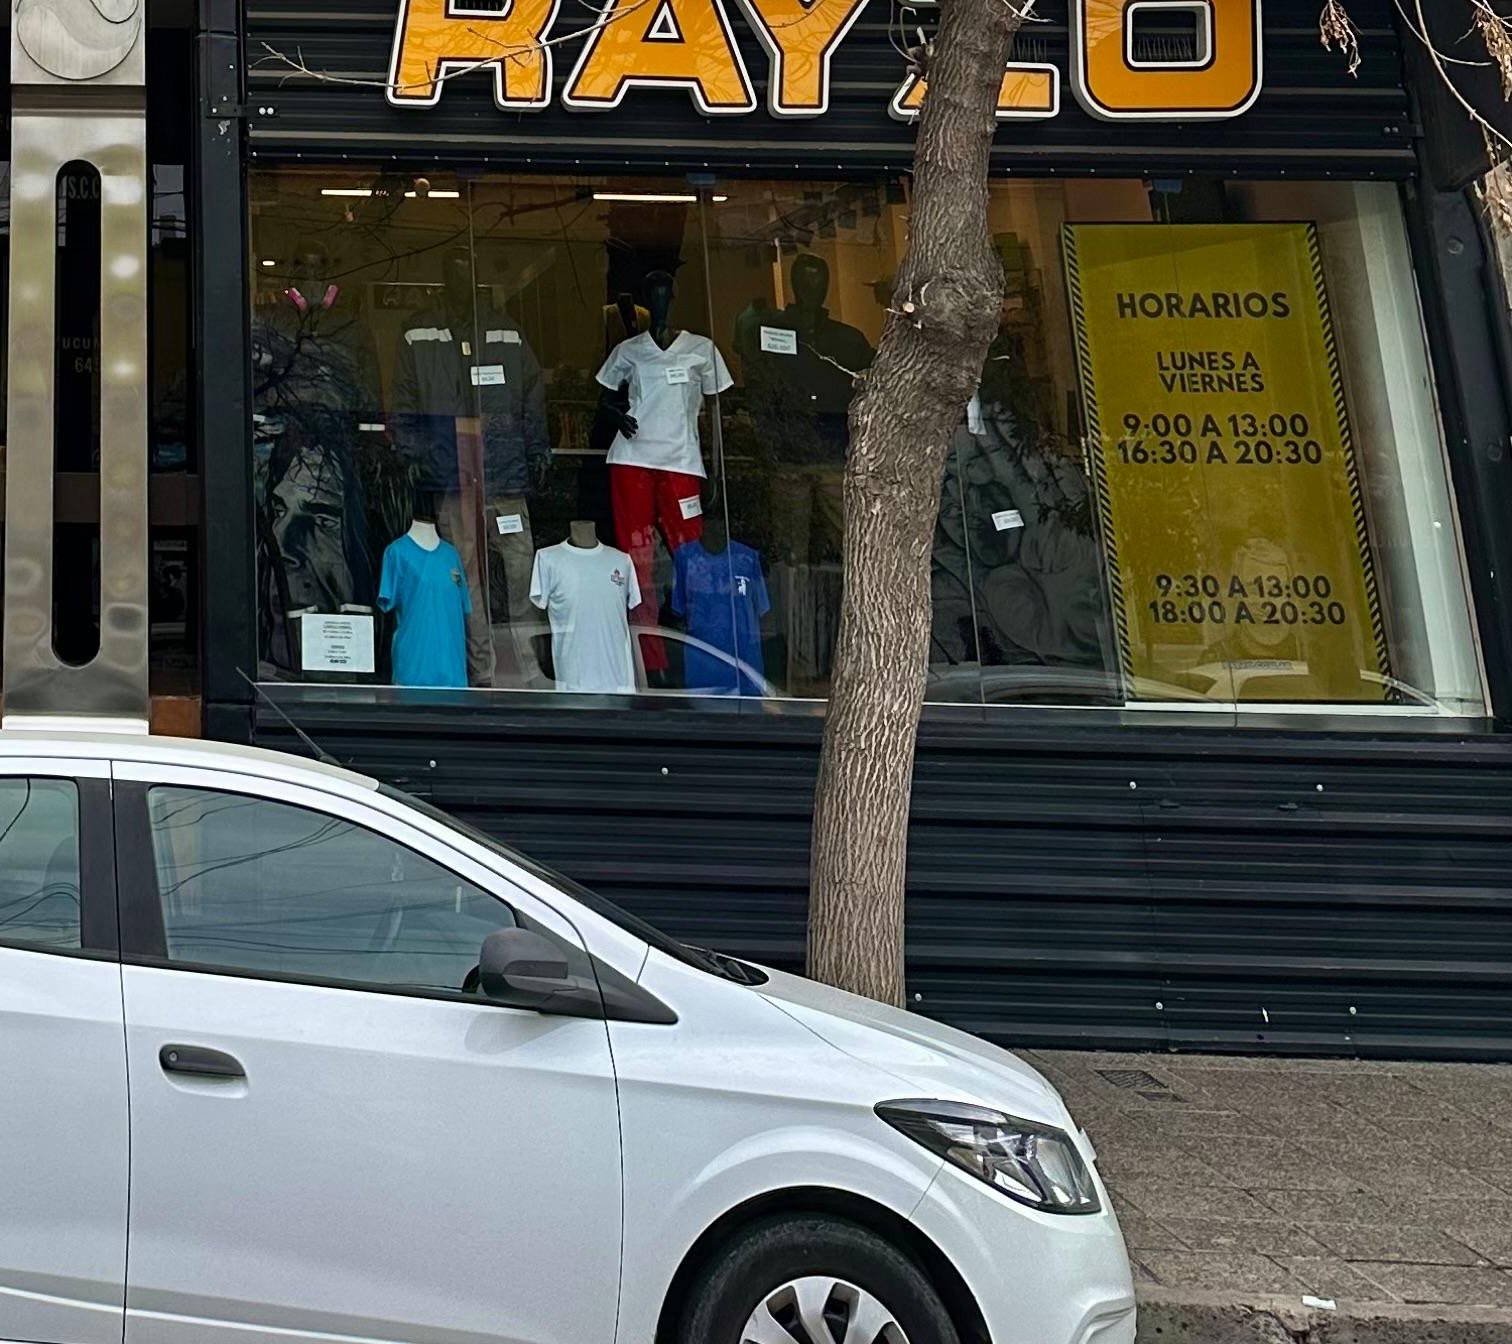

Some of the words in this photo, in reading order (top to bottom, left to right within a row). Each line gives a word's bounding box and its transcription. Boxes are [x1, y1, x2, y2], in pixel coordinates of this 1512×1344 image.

[1117, 292, 1291, 320] HORARIOS
[1157, 352, 1235, 371] LUNES
[1242, 352, 1260, 371] A
[1159, 373, 1265, 393] VIERNES
[1123, 414, 1192, 437] 9:00
[1200, 414, 1223, 437] A
[1228, 414, 1309, 437] 13:00
[1118, 441, 1197, 465] 16:30
[1207, 441, 1228, 465] A
[1233, 441, 1322, 465] 20:30
[1156, 574, 1220, 598] 9:30
[1228, 575, 1248, 598] A
[1254, 575, 1332, 599] 13:00
[1149, 600, 1226, 624] 18:00
[1235, 601, 1255, 624] A
[1261, 601, 1346, 625] 20:30
